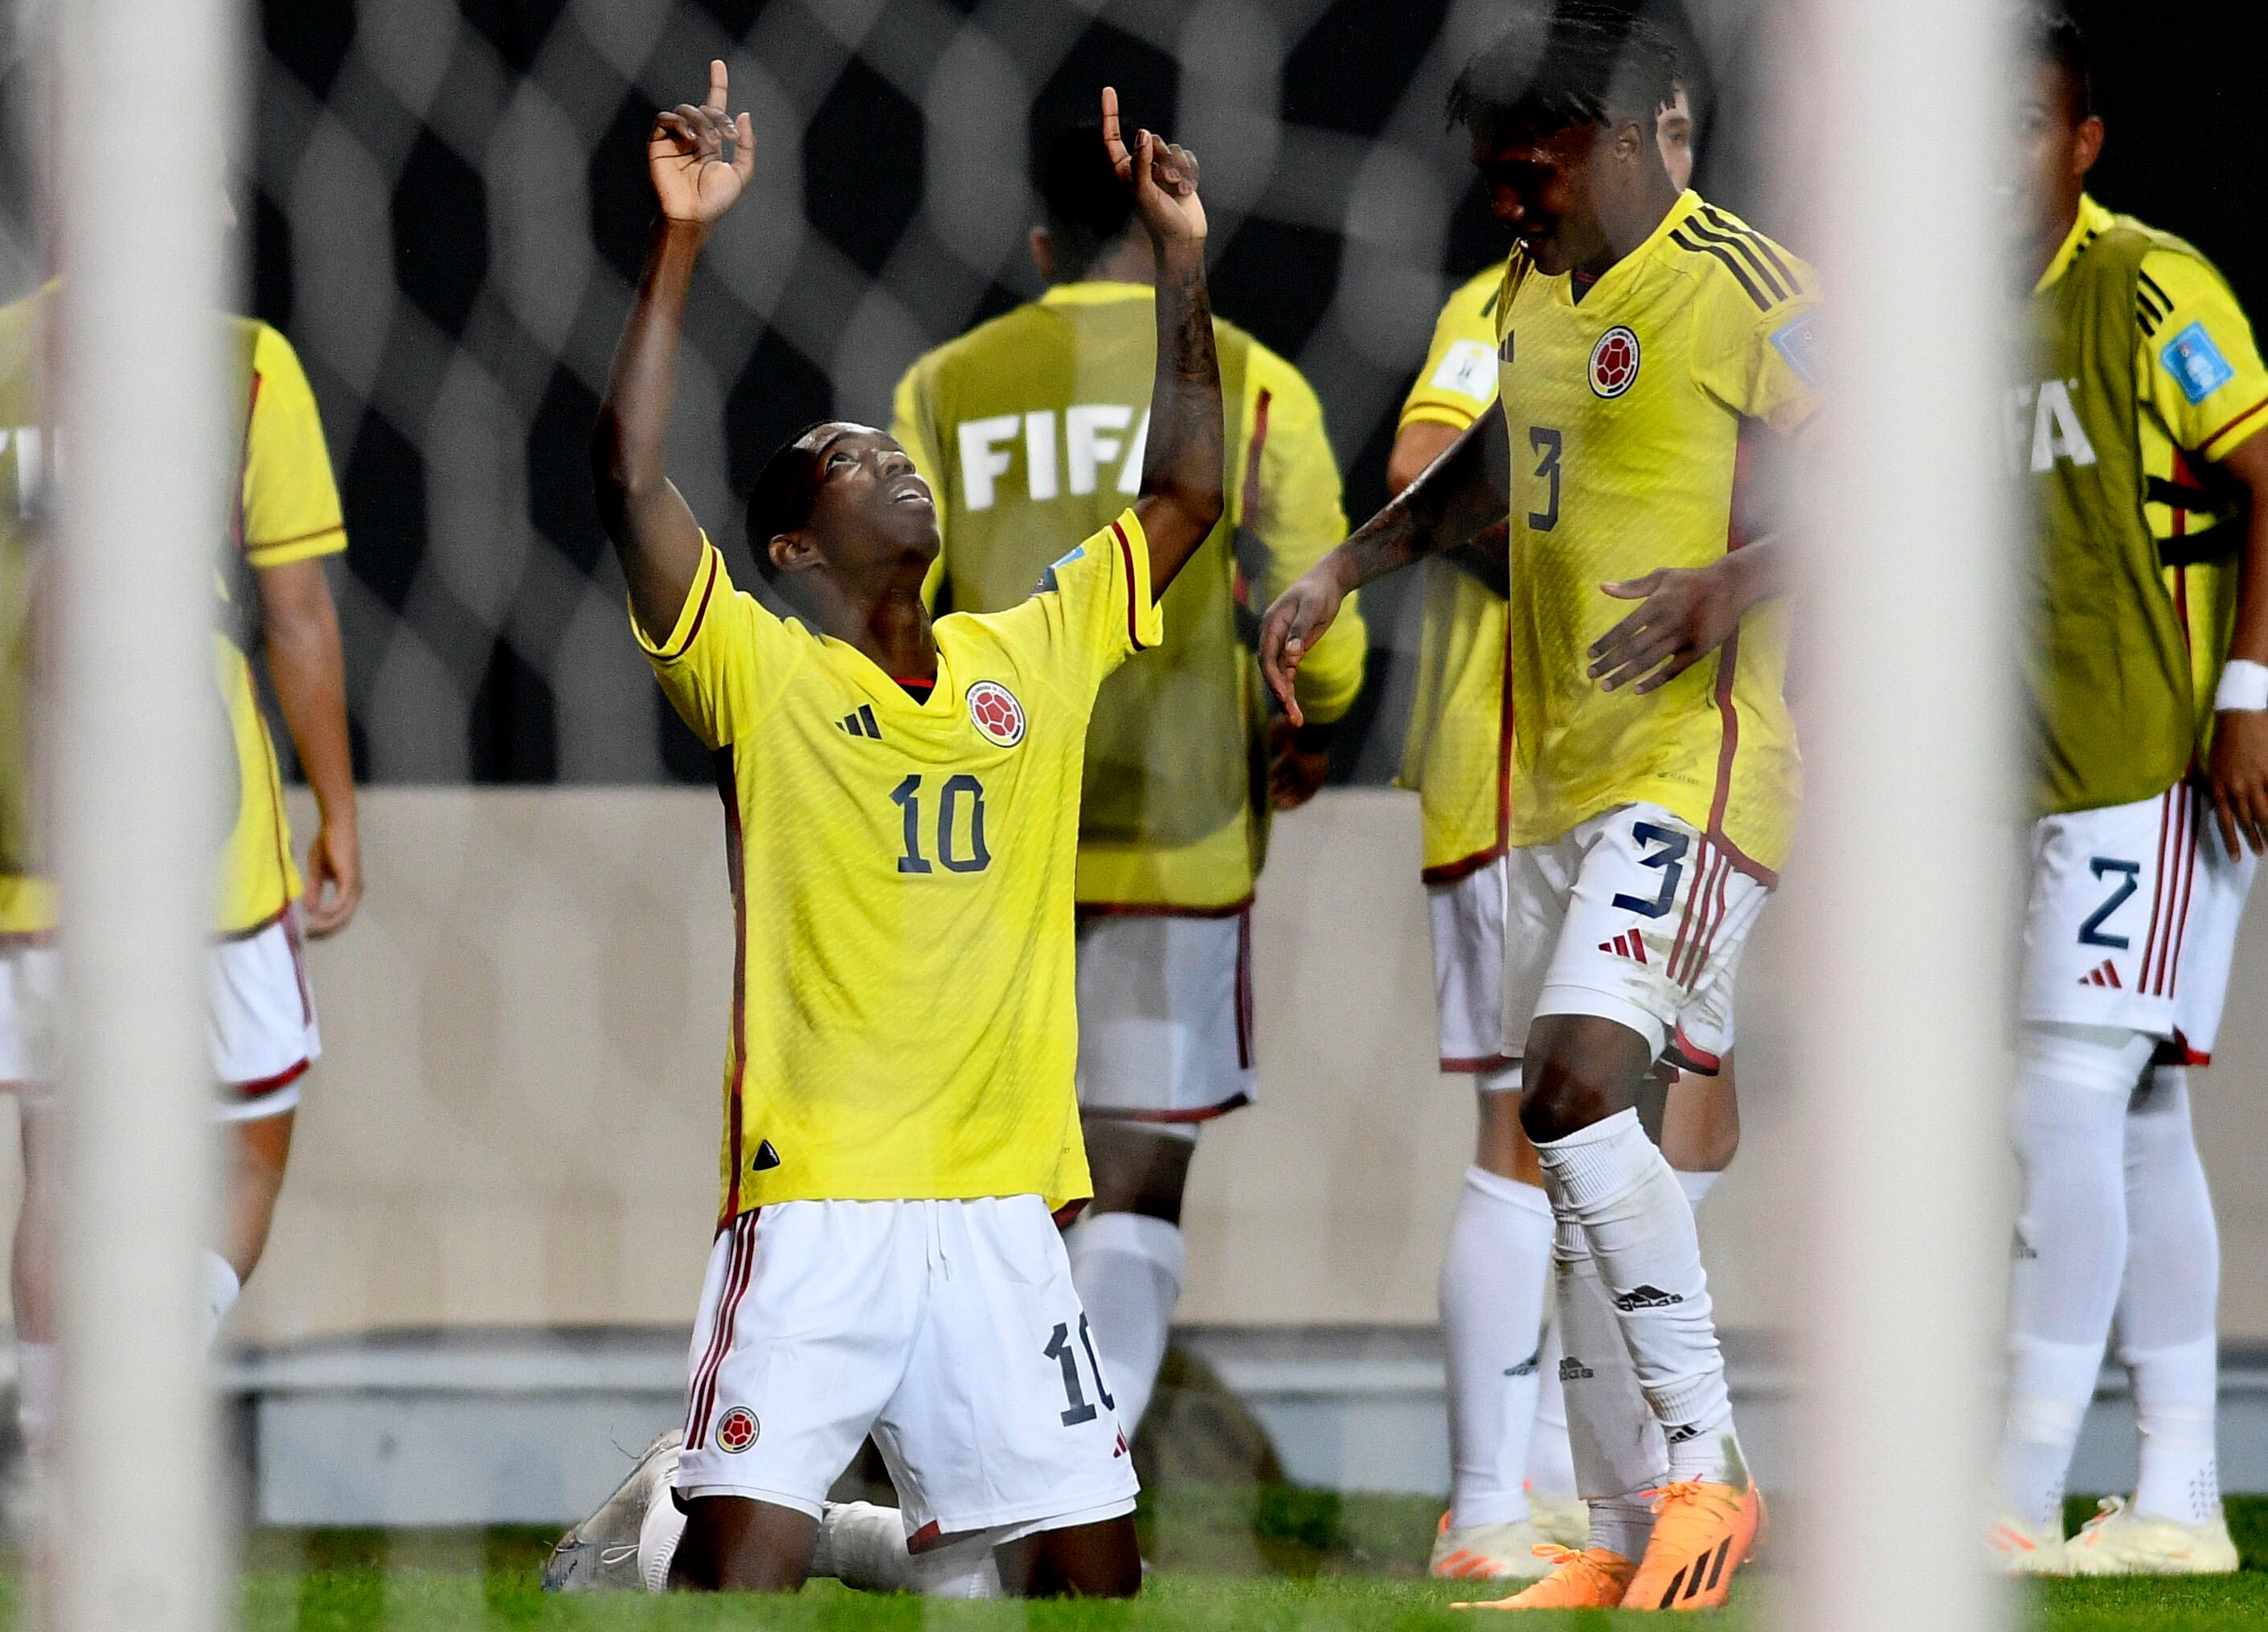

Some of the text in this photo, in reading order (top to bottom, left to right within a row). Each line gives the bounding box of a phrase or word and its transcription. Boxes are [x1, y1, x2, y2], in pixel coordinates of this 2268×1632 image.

[2013, 379, 2097, 472] A
[1529, 426, 1563, 533] 3
[888, 774, 992, 873] 10
[1611, 821, 1689, 919] 3
[2077, 856, 2140, 950] 2
